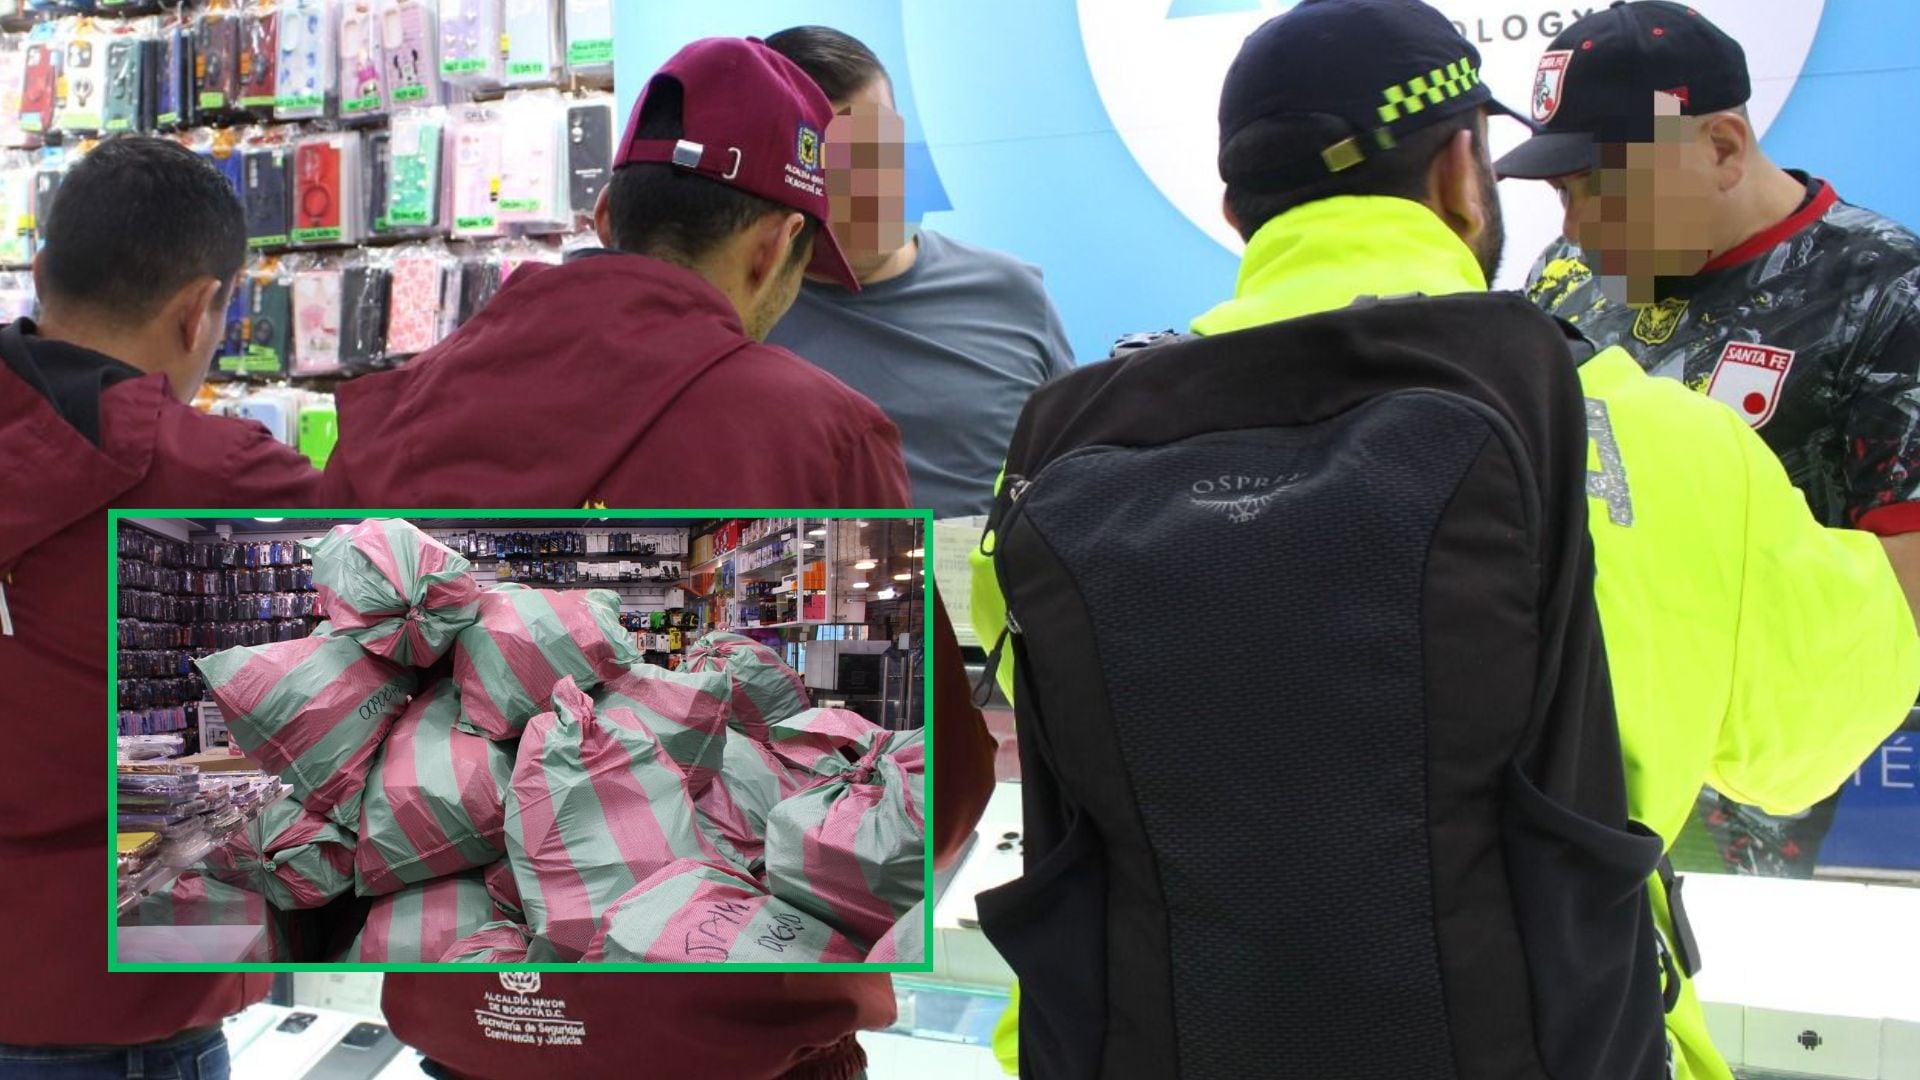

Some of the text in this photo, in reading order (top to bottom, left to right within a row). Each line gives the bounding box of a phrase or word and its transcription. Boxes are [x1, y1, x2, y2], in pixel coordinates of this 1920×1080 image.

[1725, 346, 1788, 370] SANTA FE
[488, 1002, 500, 1012] DE
[532, 998, 565, 1009] MAYOR
[524, 1022, 537, 1032] de
[538, 1022, 586, 1036] Seguridad
[536, 1035, 543, 1047] y
[545, 1034, 583, 1045] Justicia
